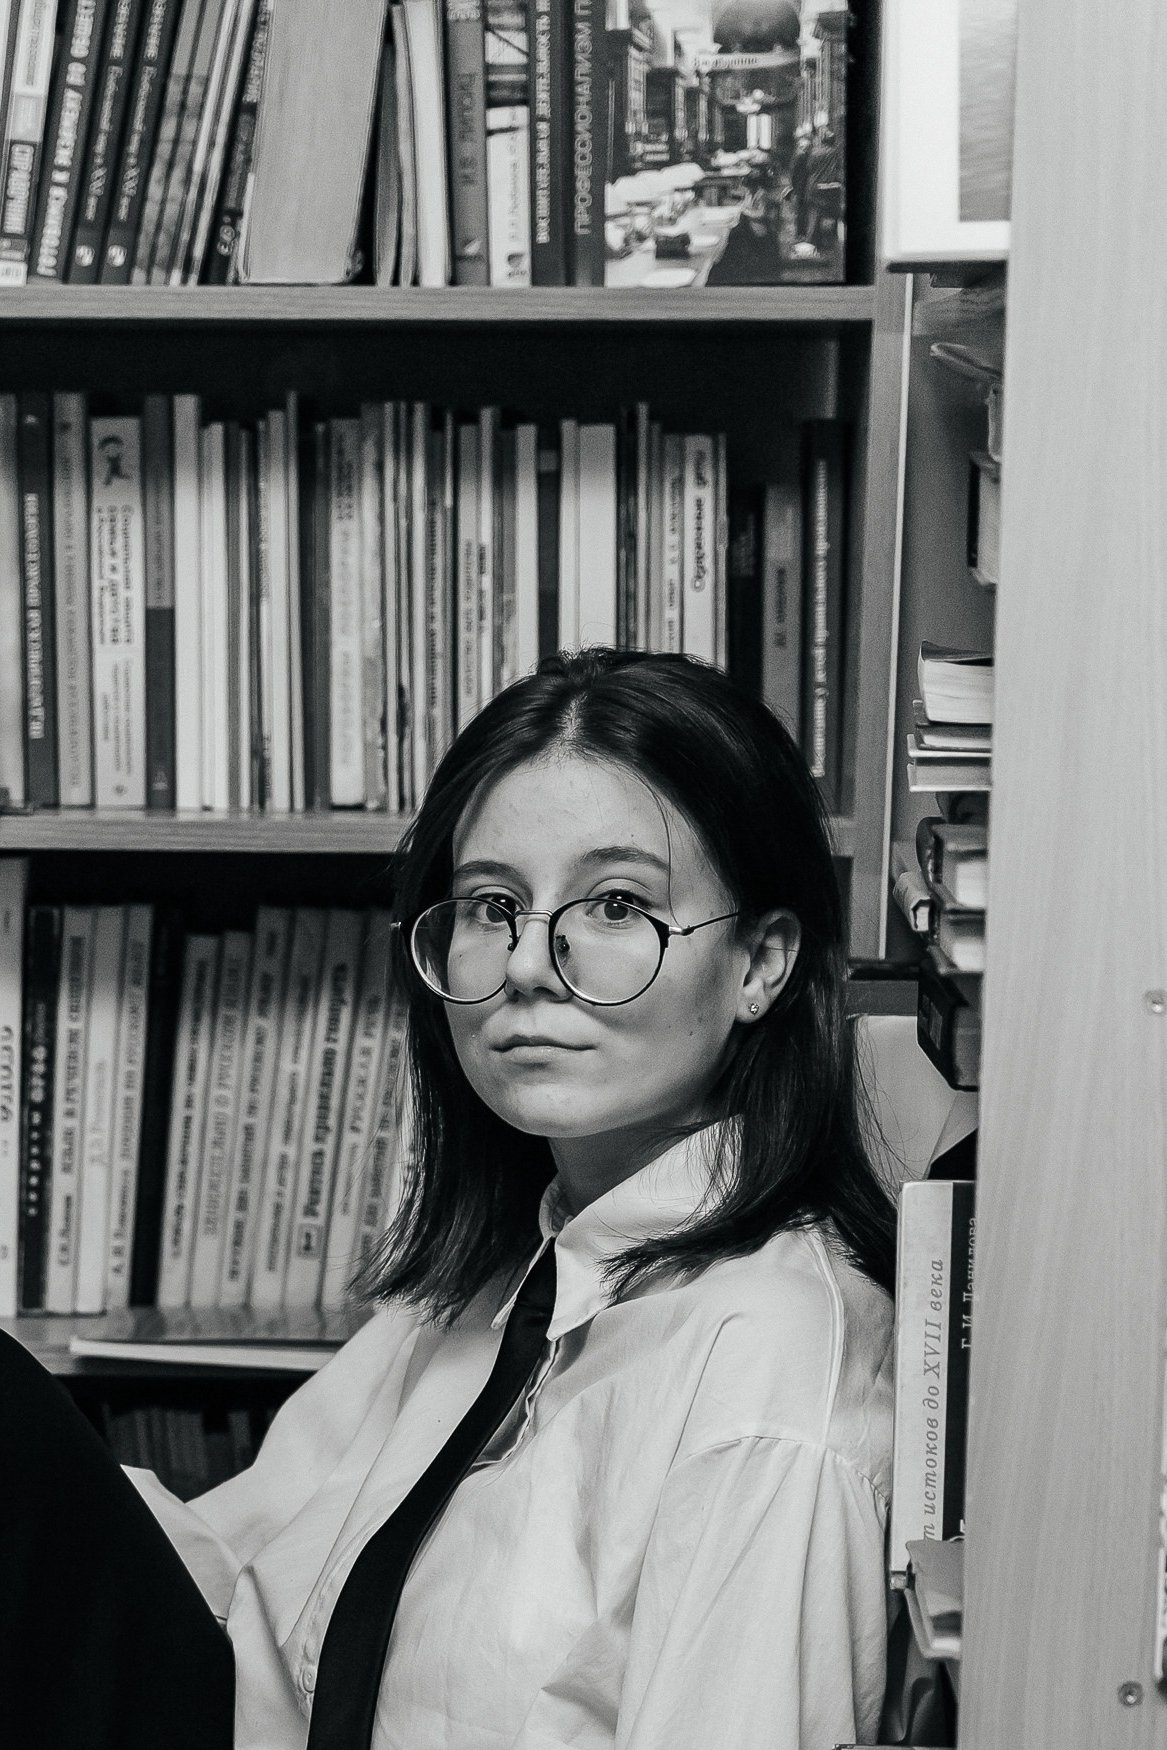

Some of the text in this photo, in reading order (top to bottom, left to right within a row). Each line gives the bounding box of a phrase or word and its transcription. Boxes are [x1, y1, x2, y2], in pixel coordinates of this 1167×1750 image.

[573, 20, 594, 235] ПРОФЕССИОНАЛИЗМ
[928, 1259, 945, 1312] века
[923, 1318, 943, 1379] XVII
[922, 1385, 941, 1411] до
[922, 1417, 940, 1516] истоков
